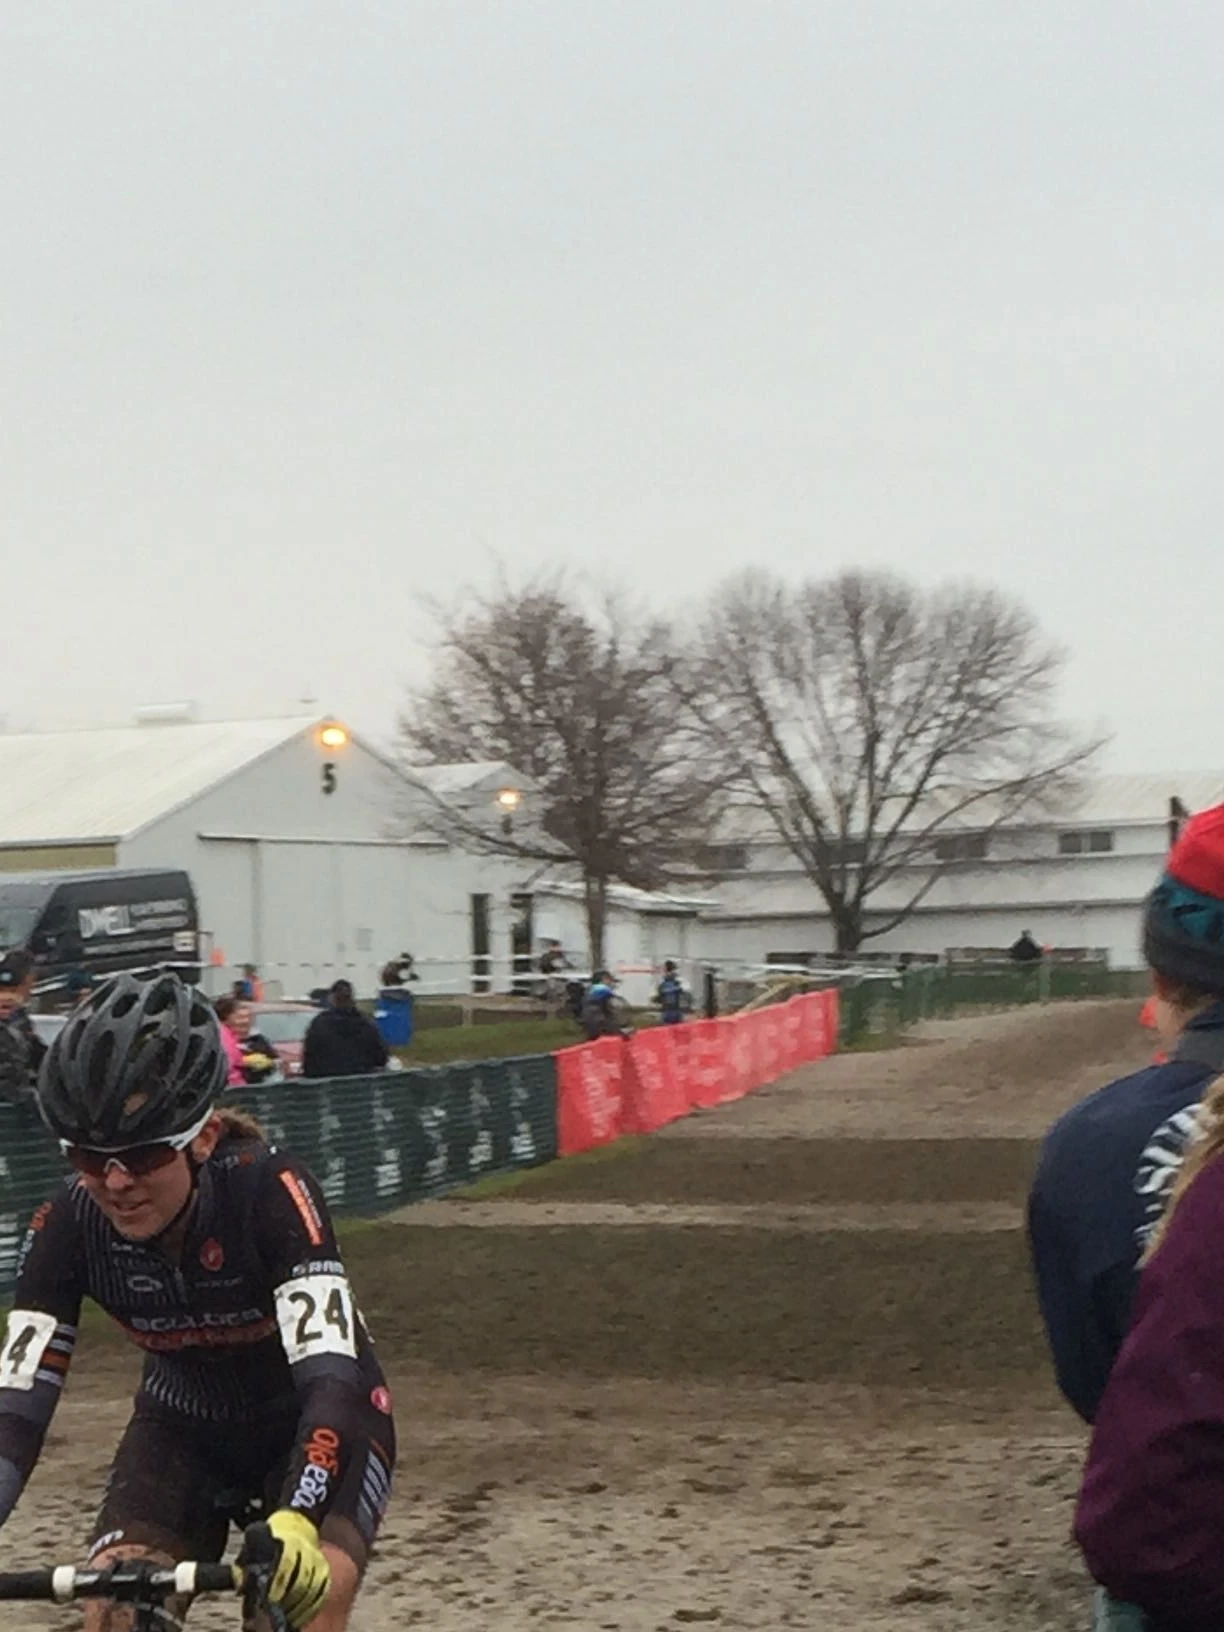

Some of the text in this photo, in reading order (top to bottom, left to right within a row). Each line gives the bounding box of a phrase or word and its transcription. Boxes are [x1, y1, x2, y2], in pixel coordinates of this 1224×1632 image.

[321, 762, 337, 795] 5
[288, 1288, 349, 1346] 24
[7, 1324, 37, 1375] 4
